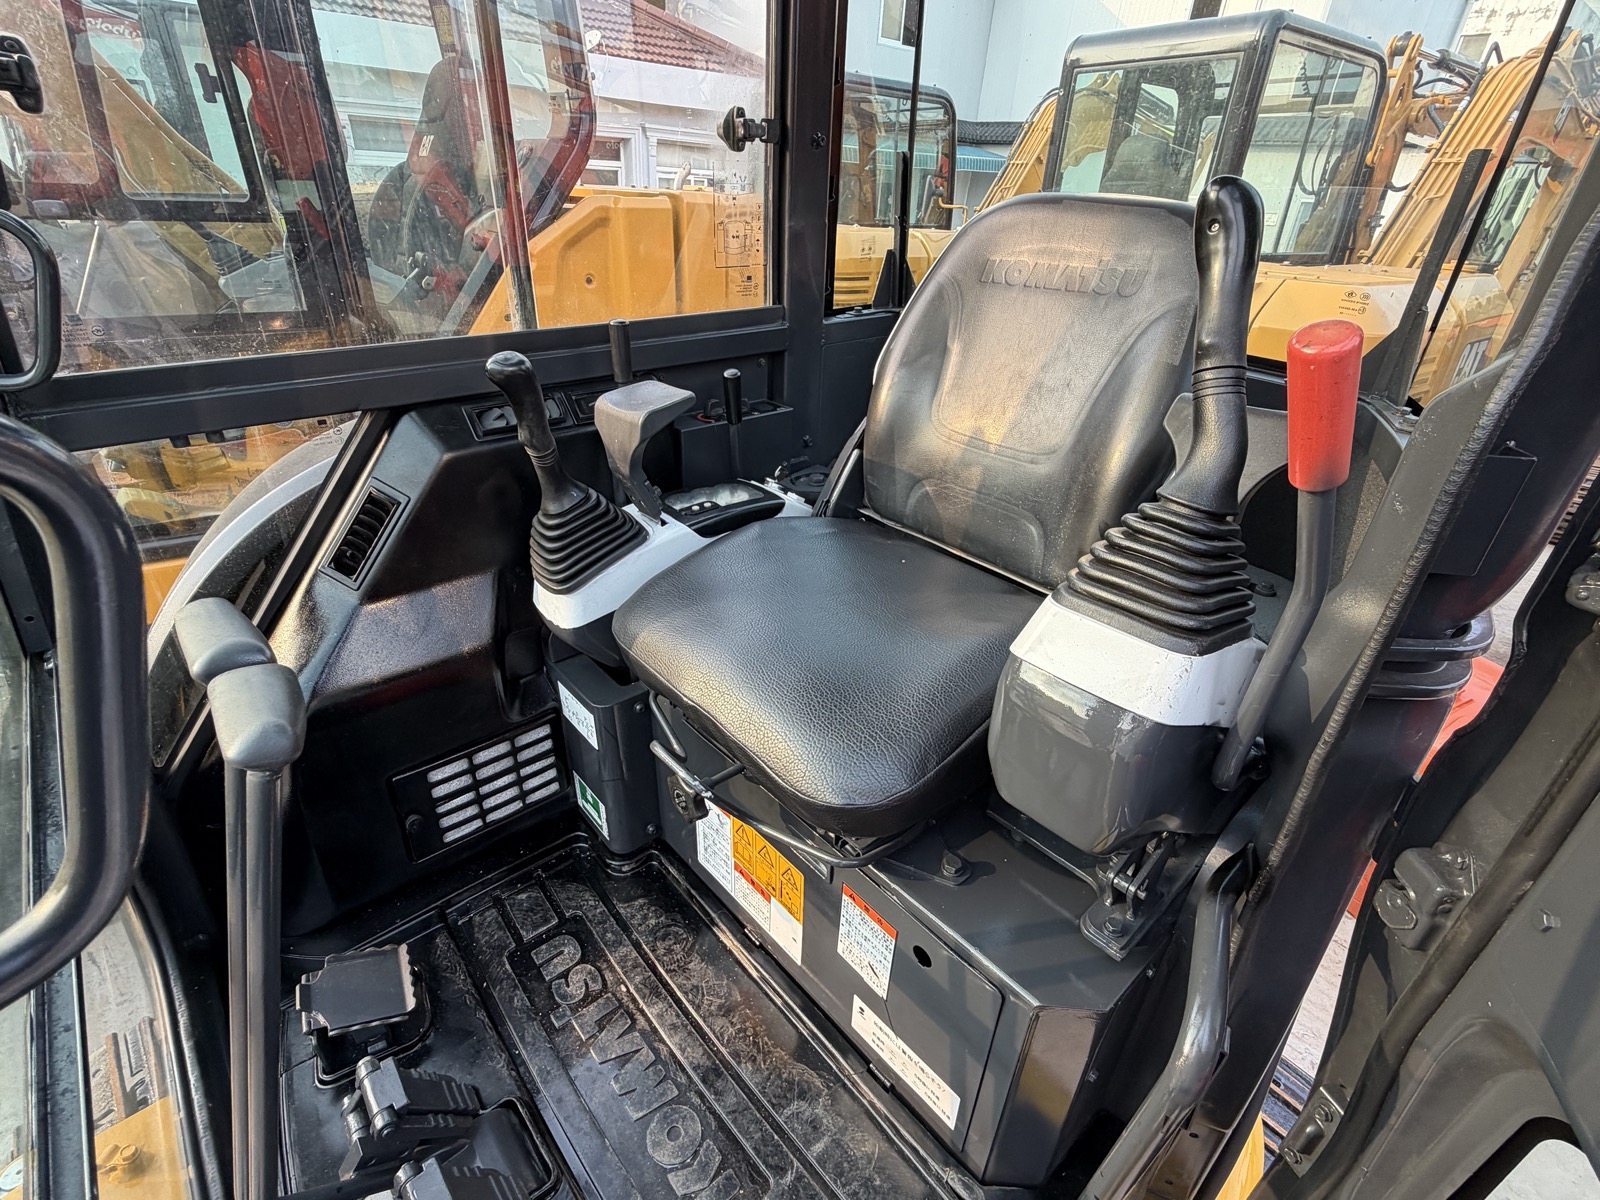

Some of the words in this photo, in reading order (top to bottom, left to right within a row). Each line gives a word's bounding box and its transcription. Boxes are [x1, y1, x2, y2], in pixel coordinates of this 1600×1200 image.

[979, 258, 1149, 297] KOMATSU
[1450, 340, 1489, 386] CAT
[531, 934, 741, 1200] KOMATSU
